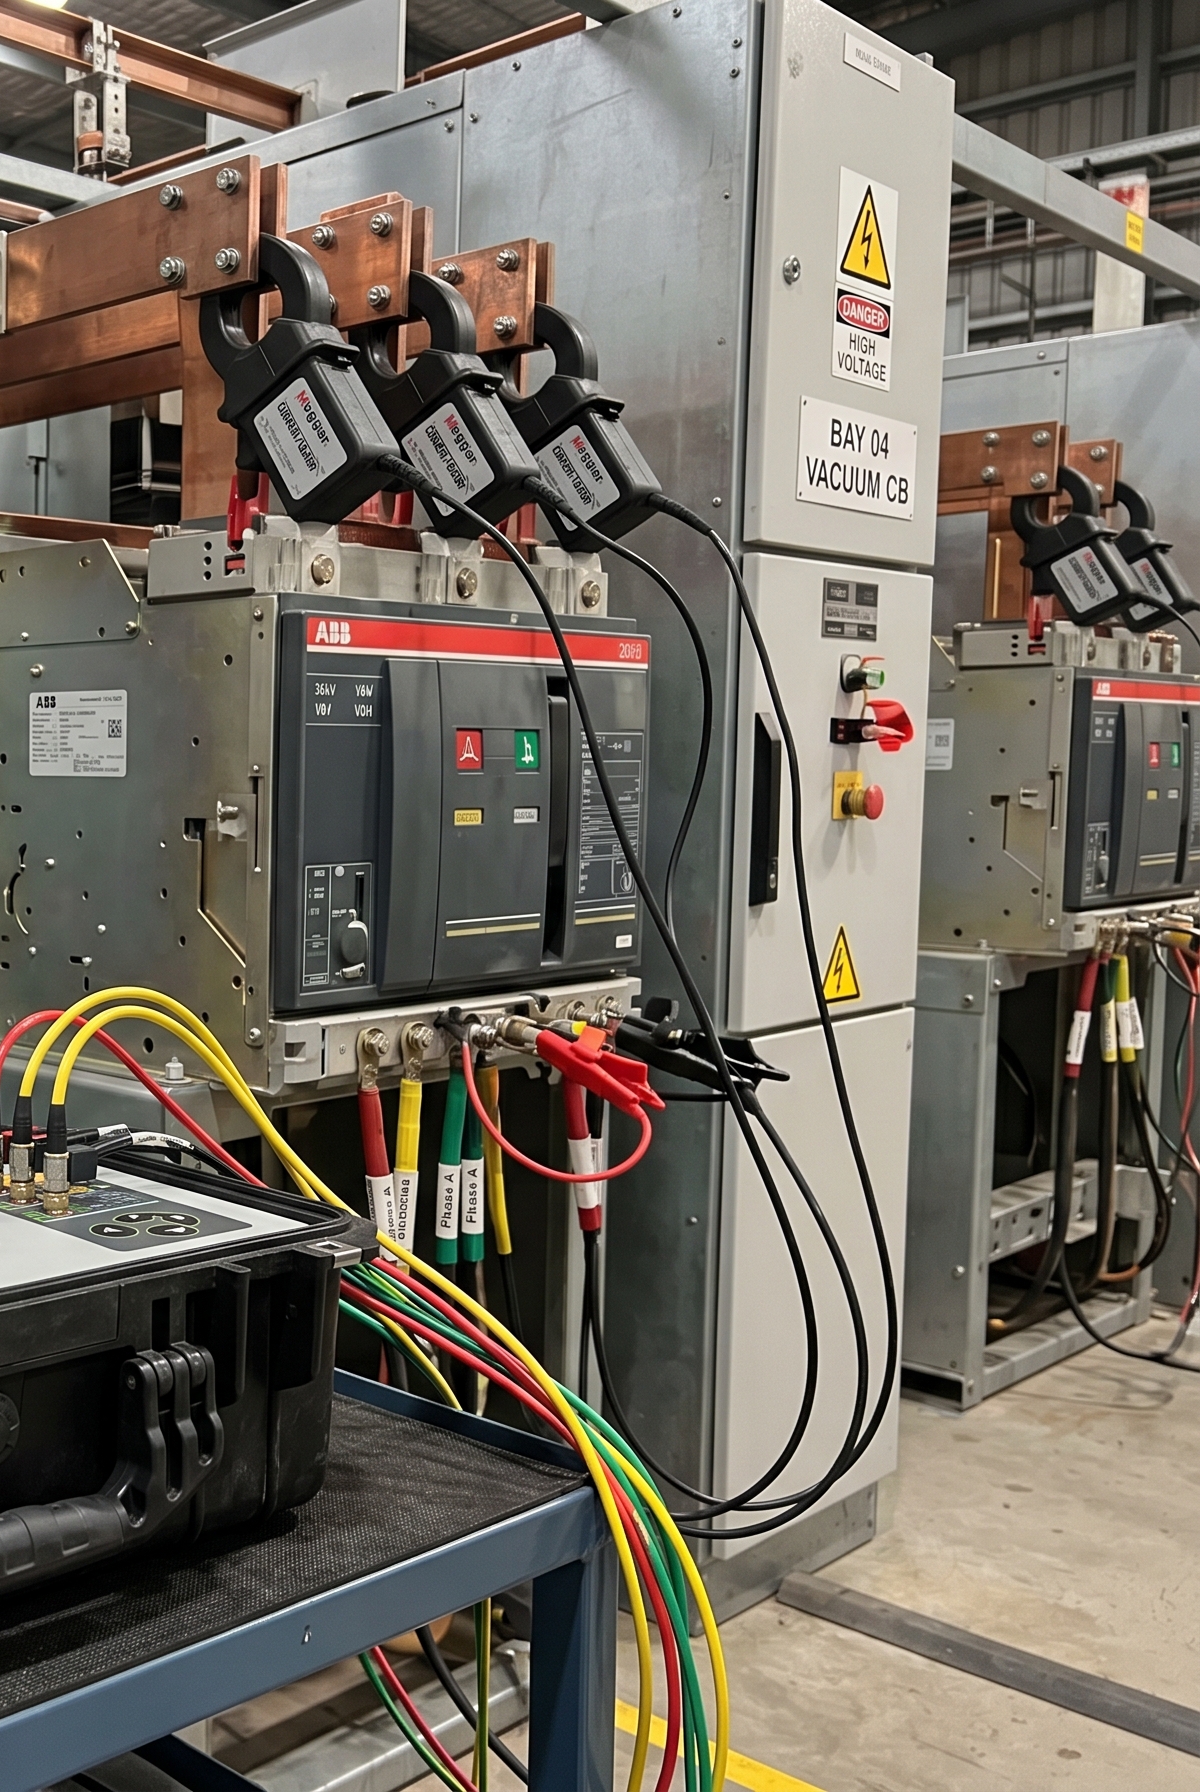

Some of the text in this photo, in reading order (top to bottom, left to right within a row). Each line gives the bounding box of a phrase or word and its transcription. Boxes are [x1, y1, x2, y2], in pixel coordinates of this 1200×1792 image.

[843, 299, 885, 329] DANGER
[849, 333, 876, 356] HIGH
[837, 351, 887, 382] VOLTAGE
[830, 418, 890, 459] BAY 04
[806, 456, 909, 505] VACUUM CB
[315, 620, 351, 645] ABB
[314, 682, 336, 696] 36kV
[36, 696, 56, 708] ABB
[444, 1173, 454, 1183] A
[467, 1168, 478, 1178] A
